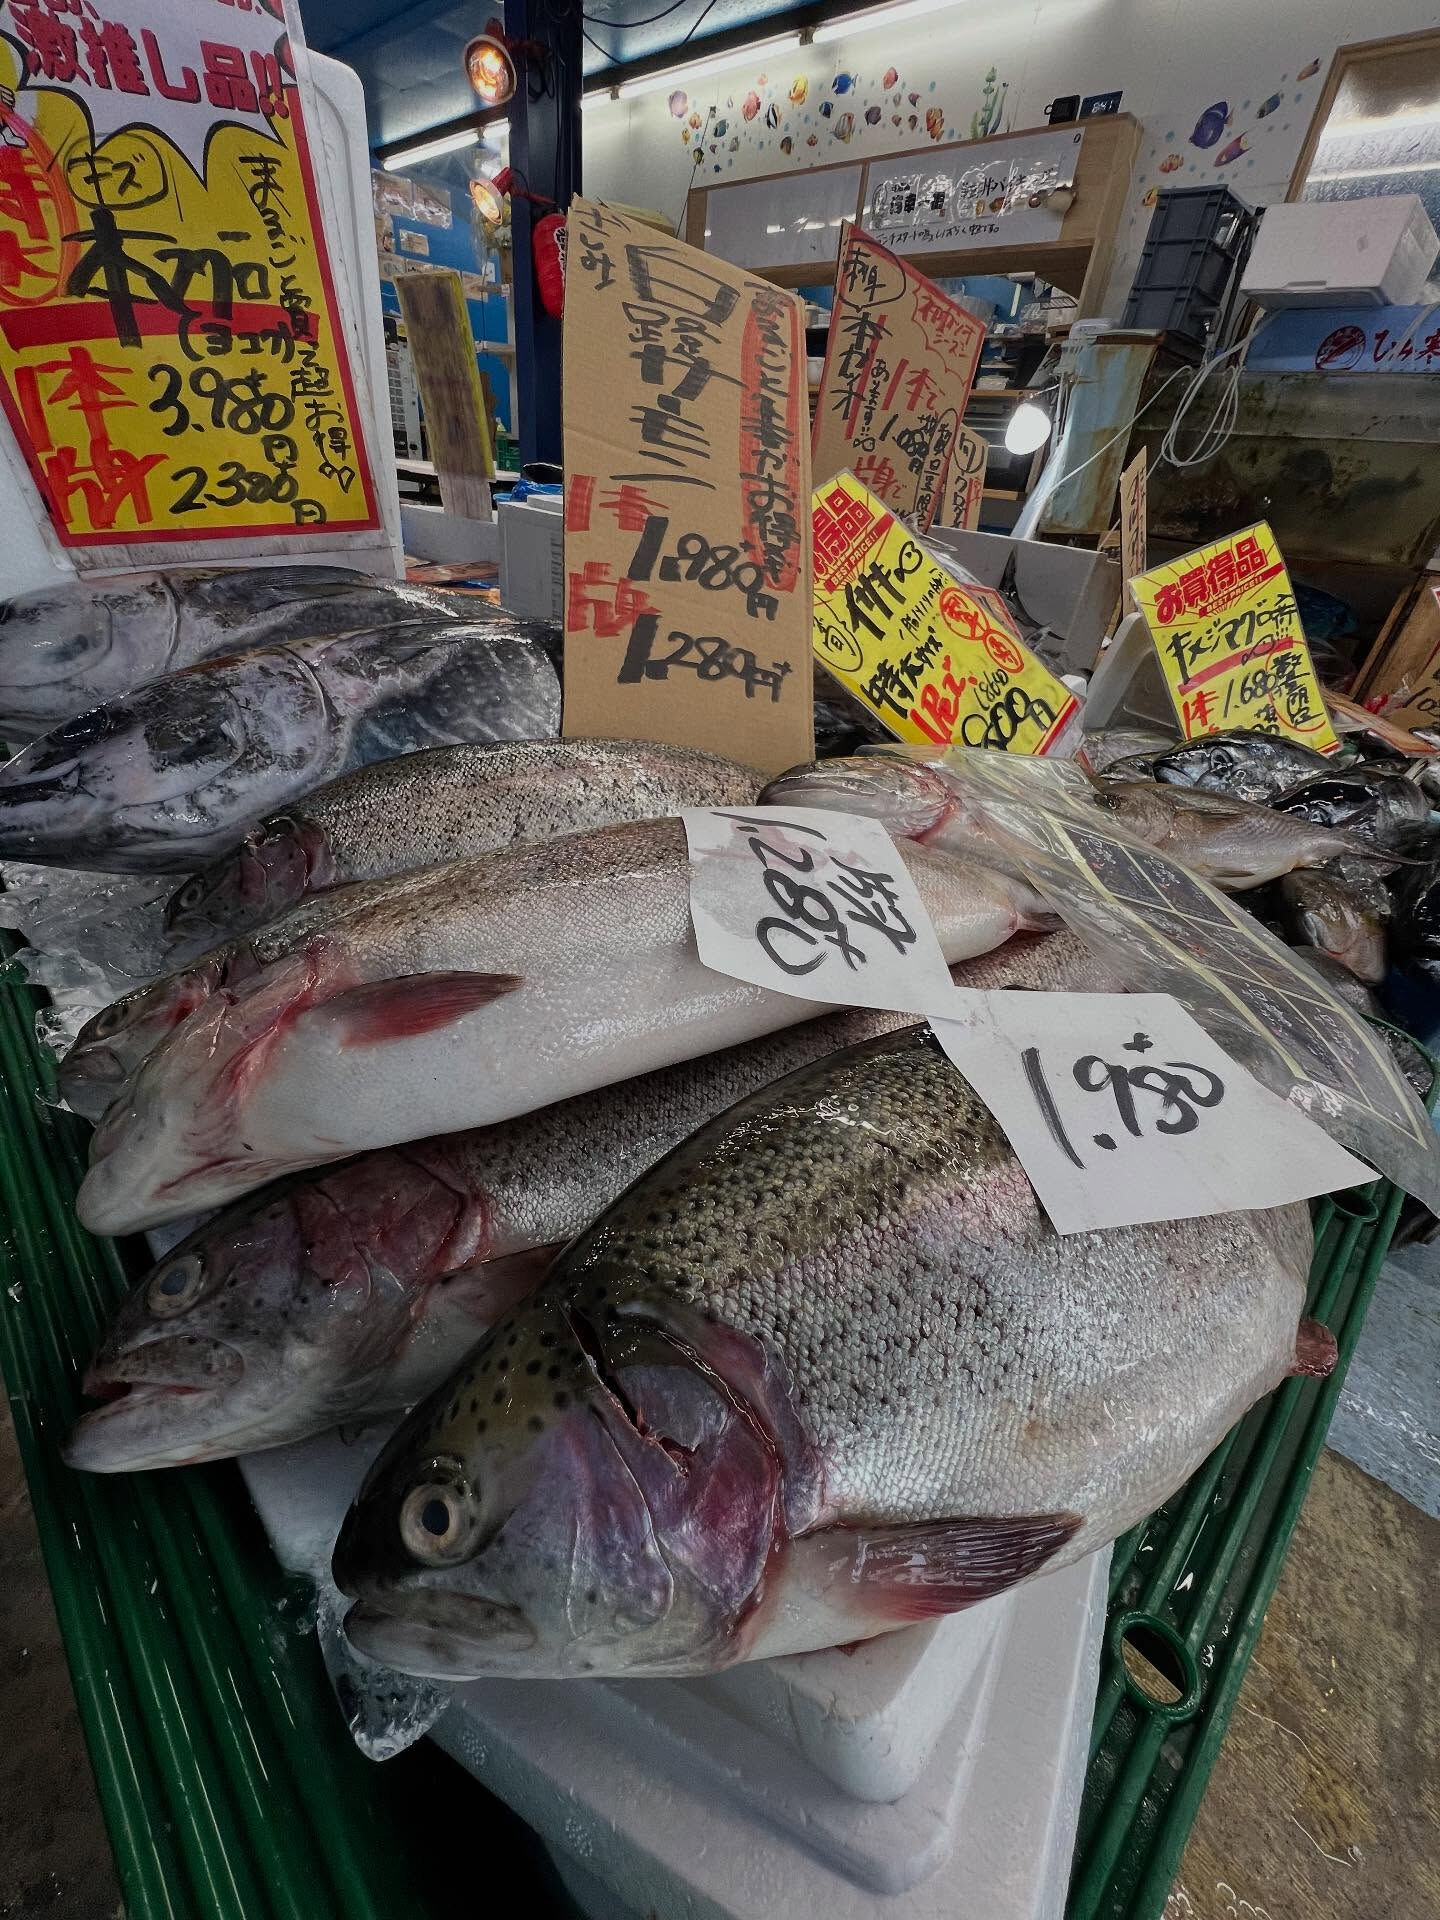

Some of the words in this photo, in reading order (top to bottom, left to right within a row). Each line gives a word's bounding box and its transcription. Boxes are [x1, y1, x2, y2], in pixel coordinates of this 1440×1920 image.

[831, 561, 851, 586] BEST
[1153, 535, 1269, 625] お買得品
[1207, 596, 1229, 611] BEST
